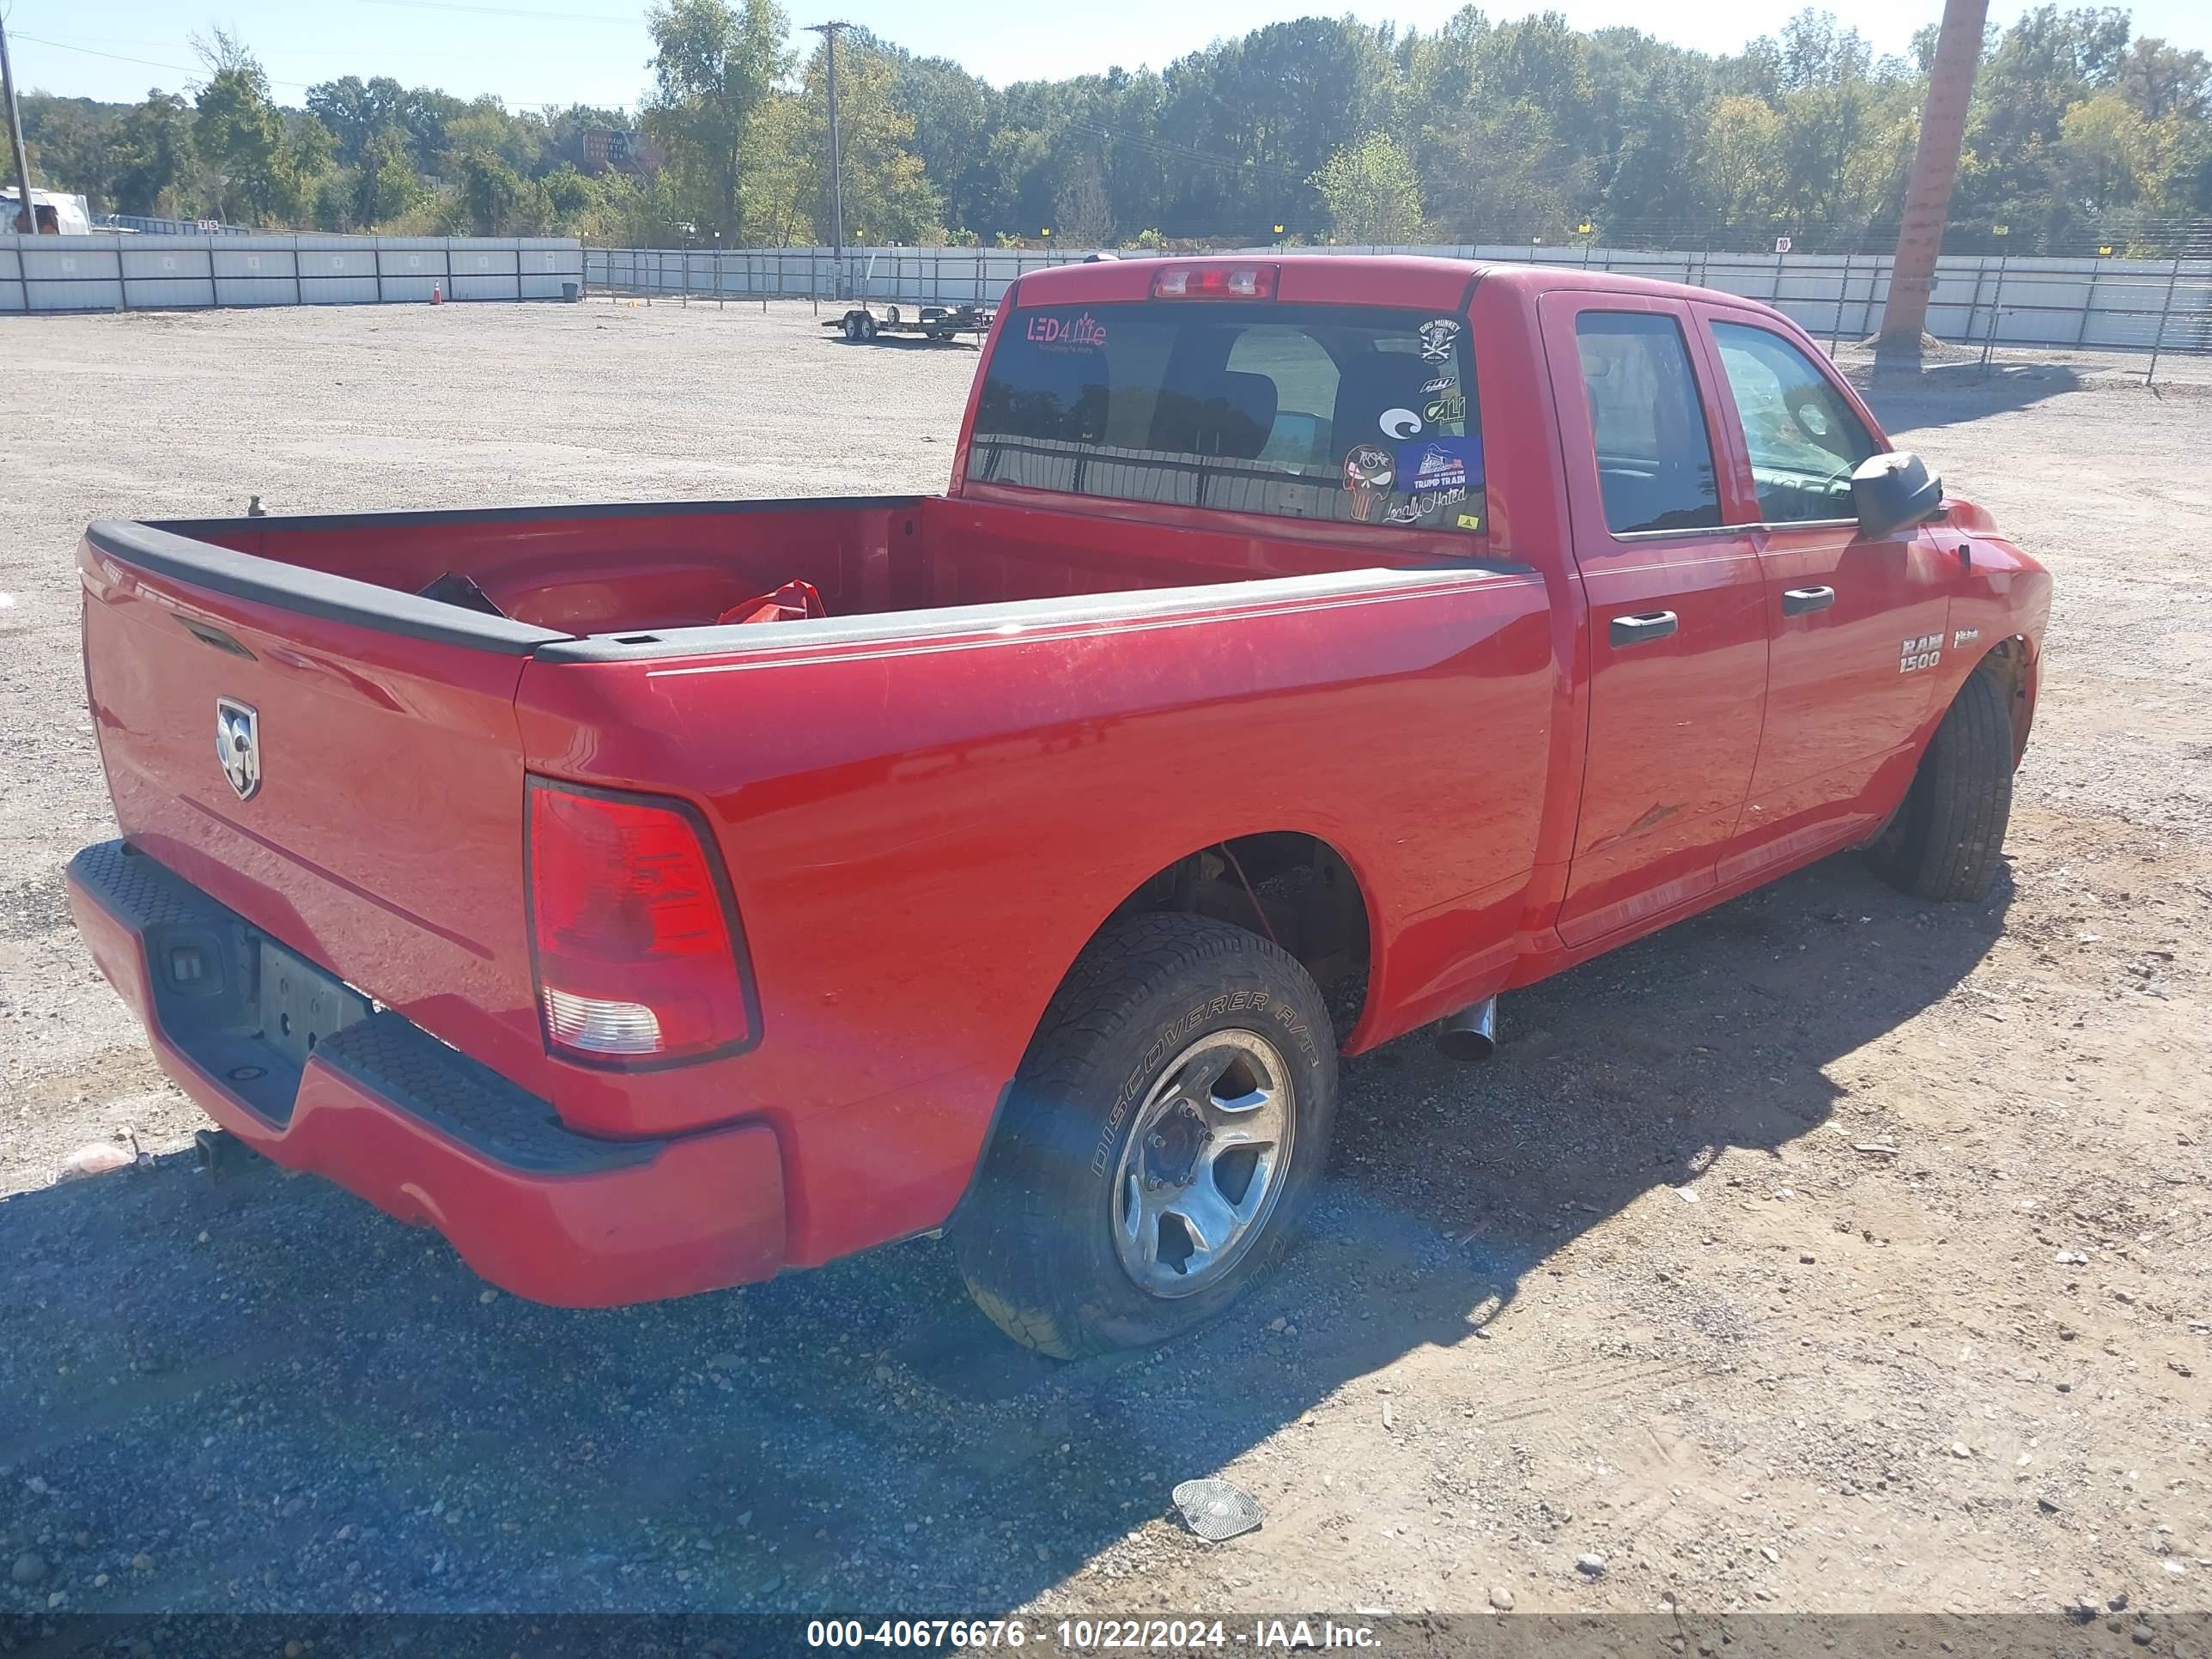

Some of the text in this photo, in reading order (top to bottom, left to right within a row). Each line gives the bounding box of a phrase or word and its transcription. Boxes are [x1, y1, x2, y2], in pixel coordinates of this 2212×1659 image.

[1779, 240, 1788, 250] 10
[1423, 396, 1465, 422] CALI
[1414, 478, 1440, 489] TRUMP
[1441, 475, 1466, 486] TRAIN
[1422, 485, 1467, 514] Hated
[1902, 634, 1944, 656] RAM
[1899, 651, 1941, 674] 1500
[1091, 990, 1270, 1177] DISCOVERER
